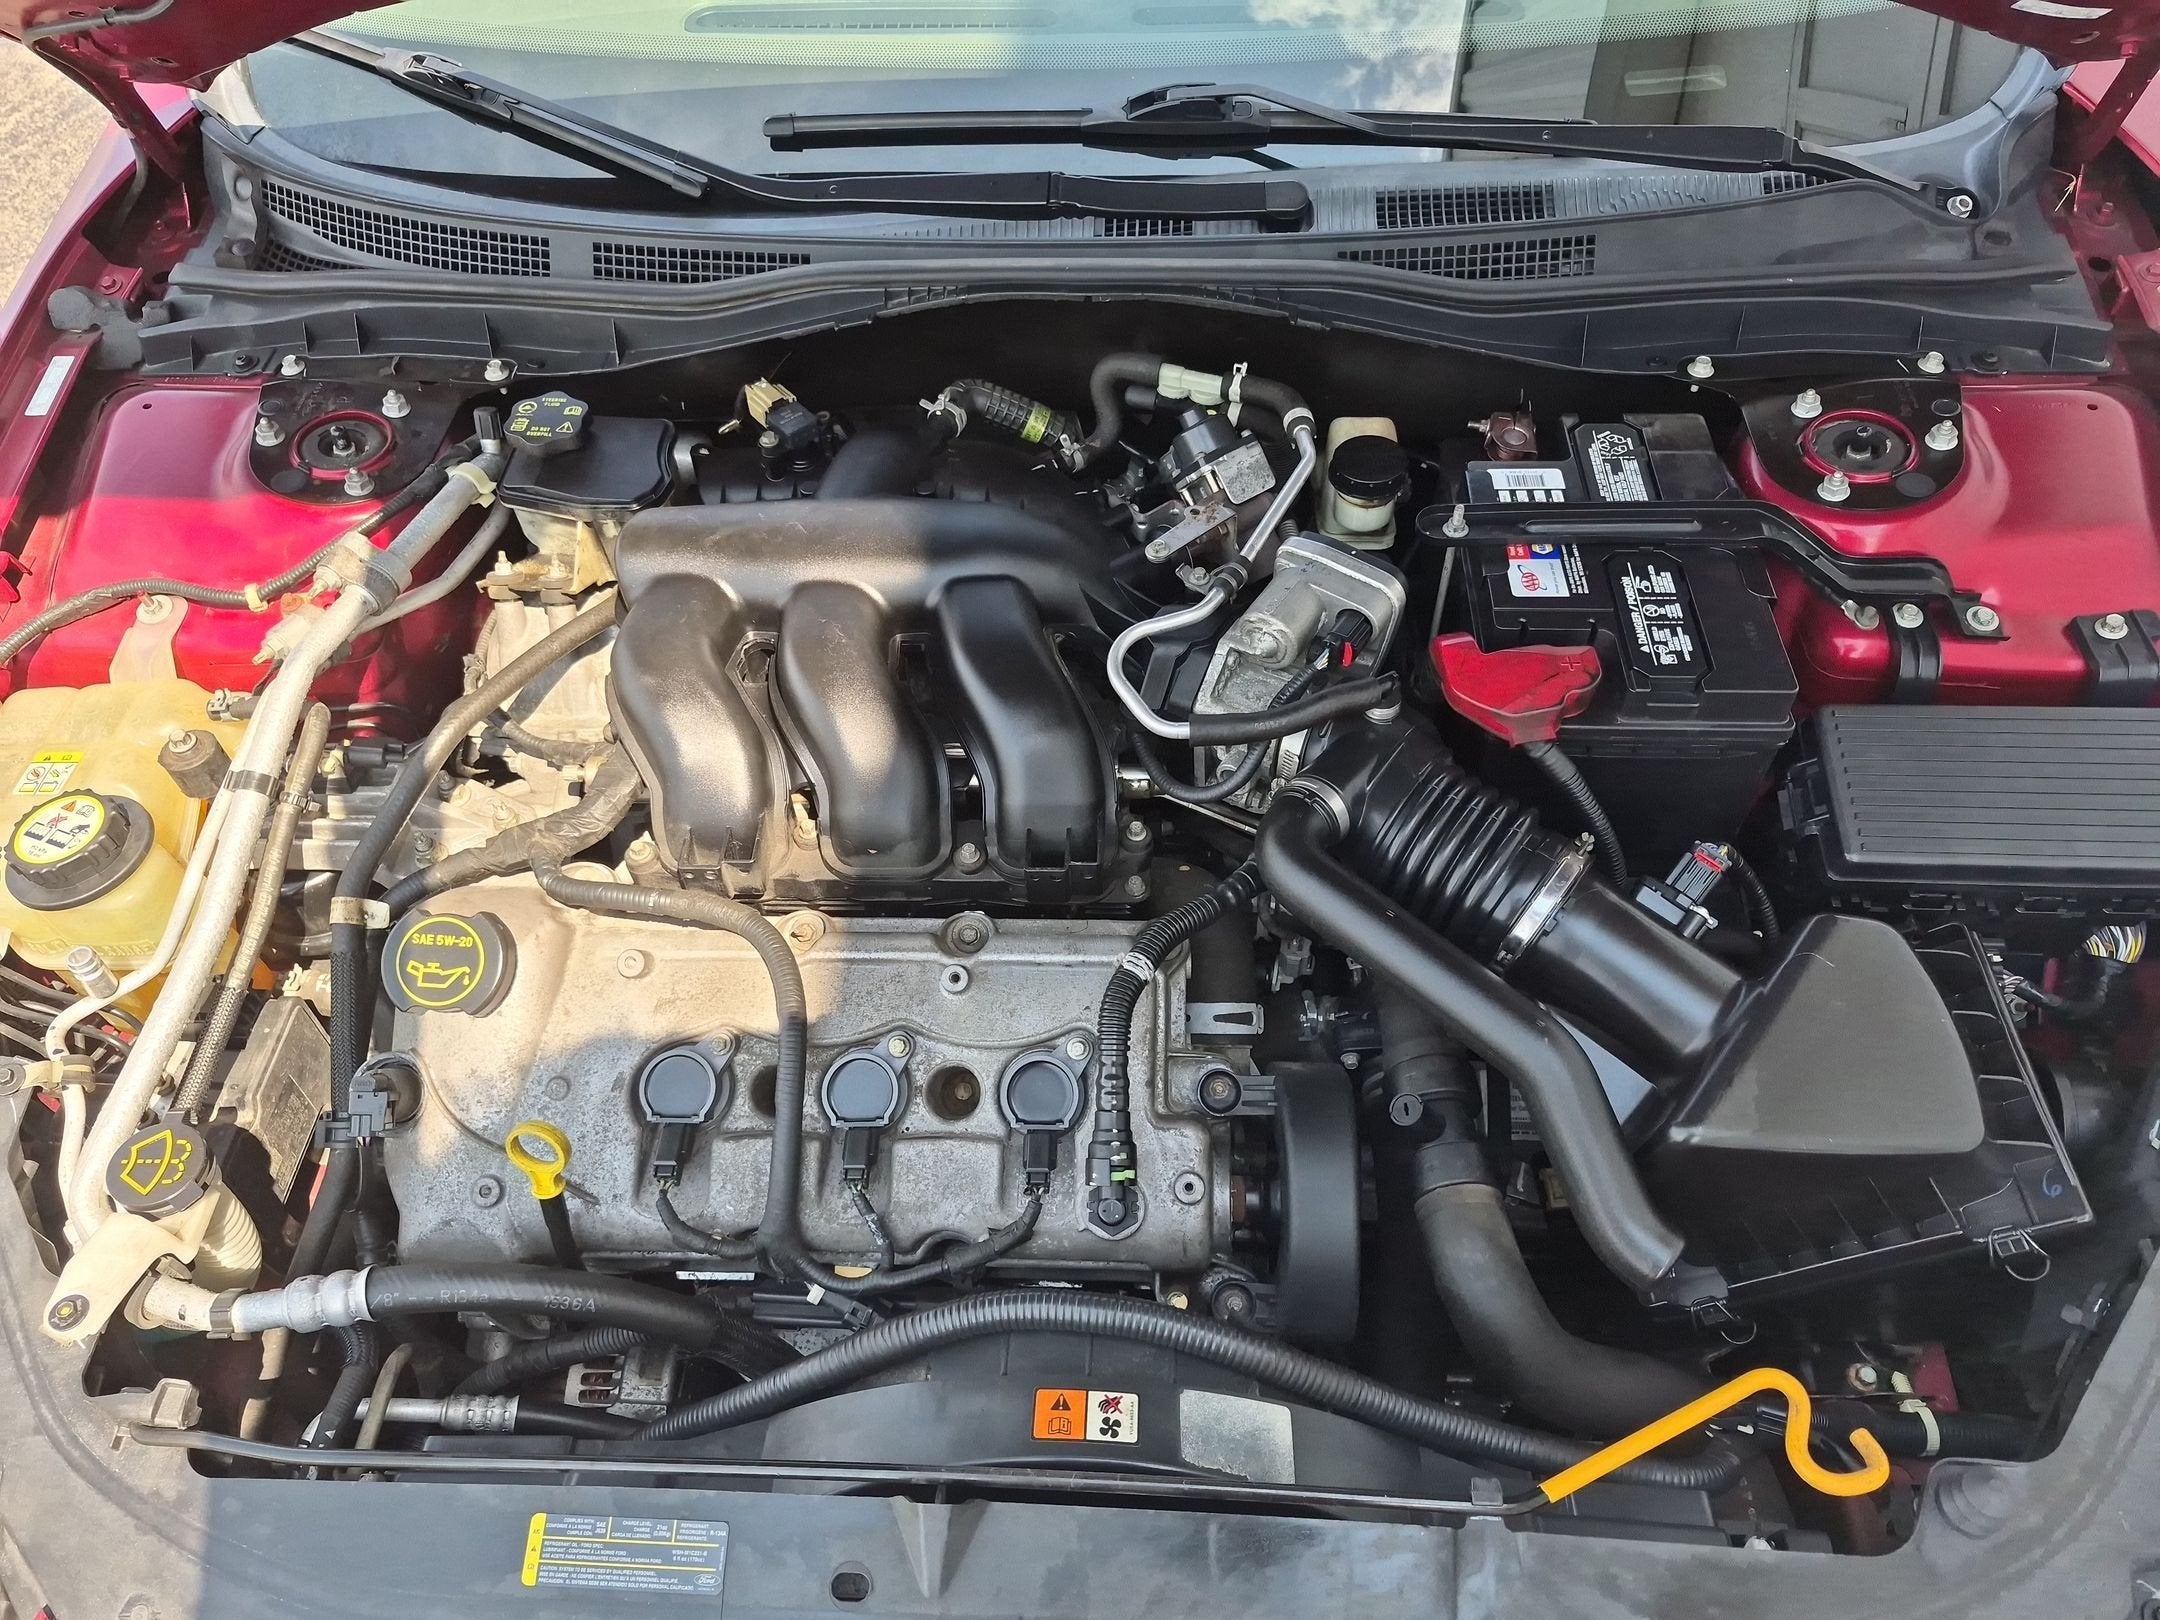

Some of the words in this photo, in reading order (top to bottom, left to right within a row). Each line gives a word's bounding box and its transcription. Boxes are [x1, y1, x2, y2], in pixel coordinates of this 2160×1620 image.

[1621, 576, 1637, 604] POISON
[1630, 611, 1648, 644] DANGER
[412, 933, 435, 945] SAE
[436, 935, 473, 947] 5W-20
[698, 1575, 716, 1584] Ford
